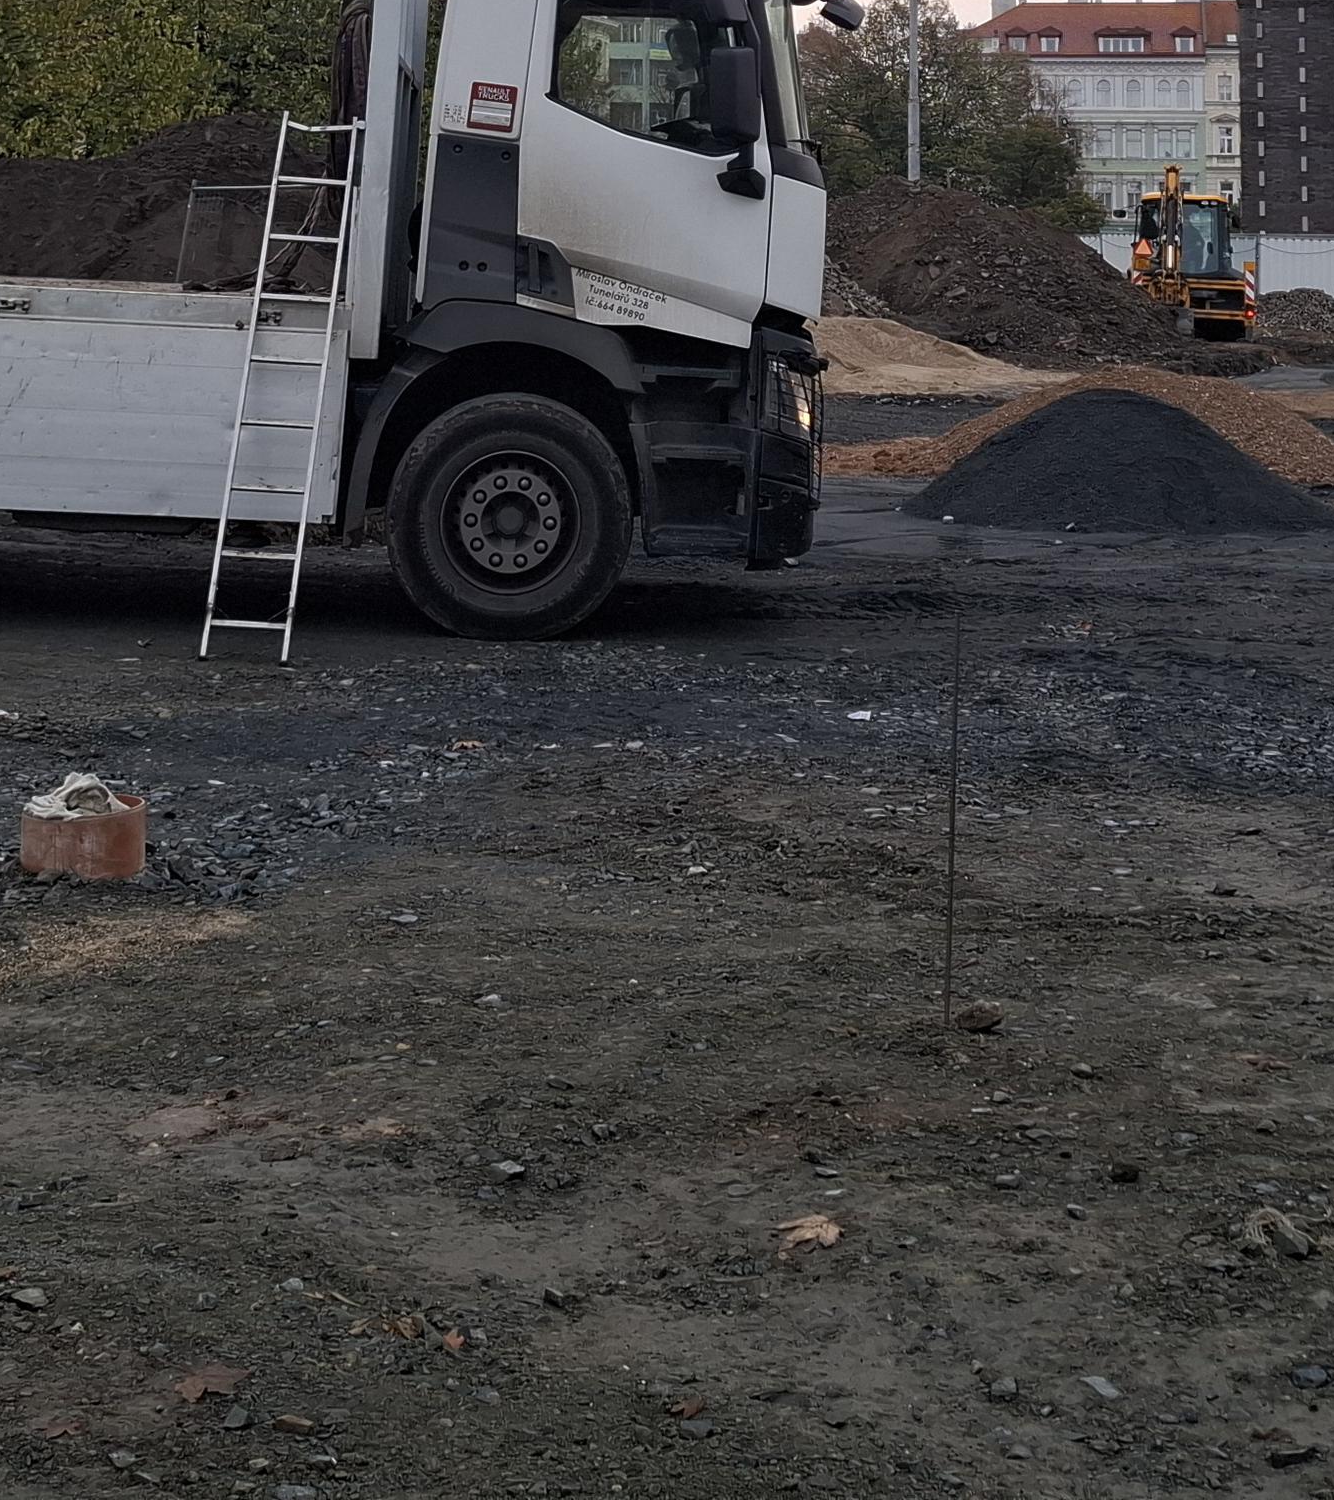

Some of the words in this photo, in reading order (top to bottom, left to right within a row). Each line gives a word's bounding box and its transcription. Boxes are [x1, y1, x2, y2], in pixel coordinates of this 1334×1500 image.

[576, 267, 617, 287] Miroslav
[631, 297, 649, 310] 328
[616, 305, 645, 321] 89890
